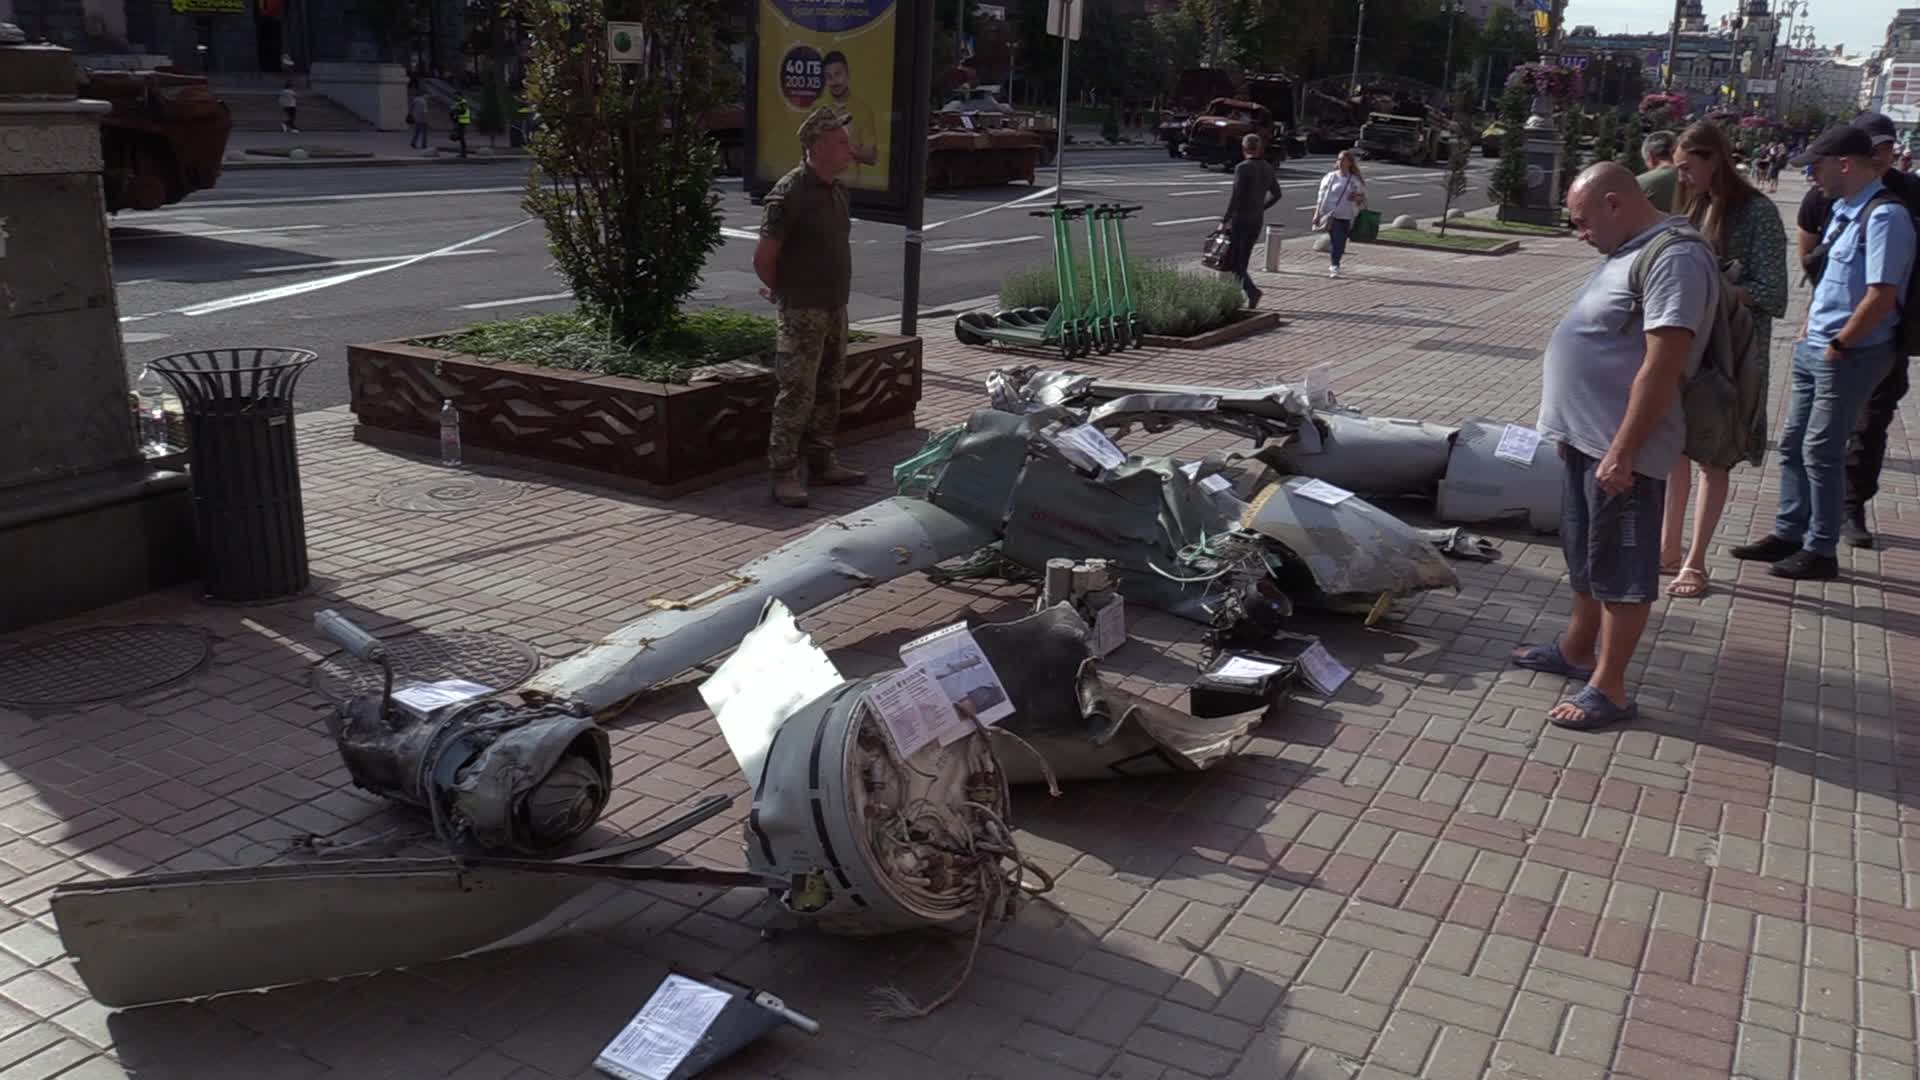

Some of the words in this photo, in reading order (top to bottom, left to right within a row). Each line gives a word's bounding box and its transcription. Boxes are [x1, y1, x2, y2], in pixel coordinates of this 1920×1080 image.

[786, 59, 804, 75] 40
[806, 60, 822, 75] ГБ
[786, 75, 806, 88] 200
